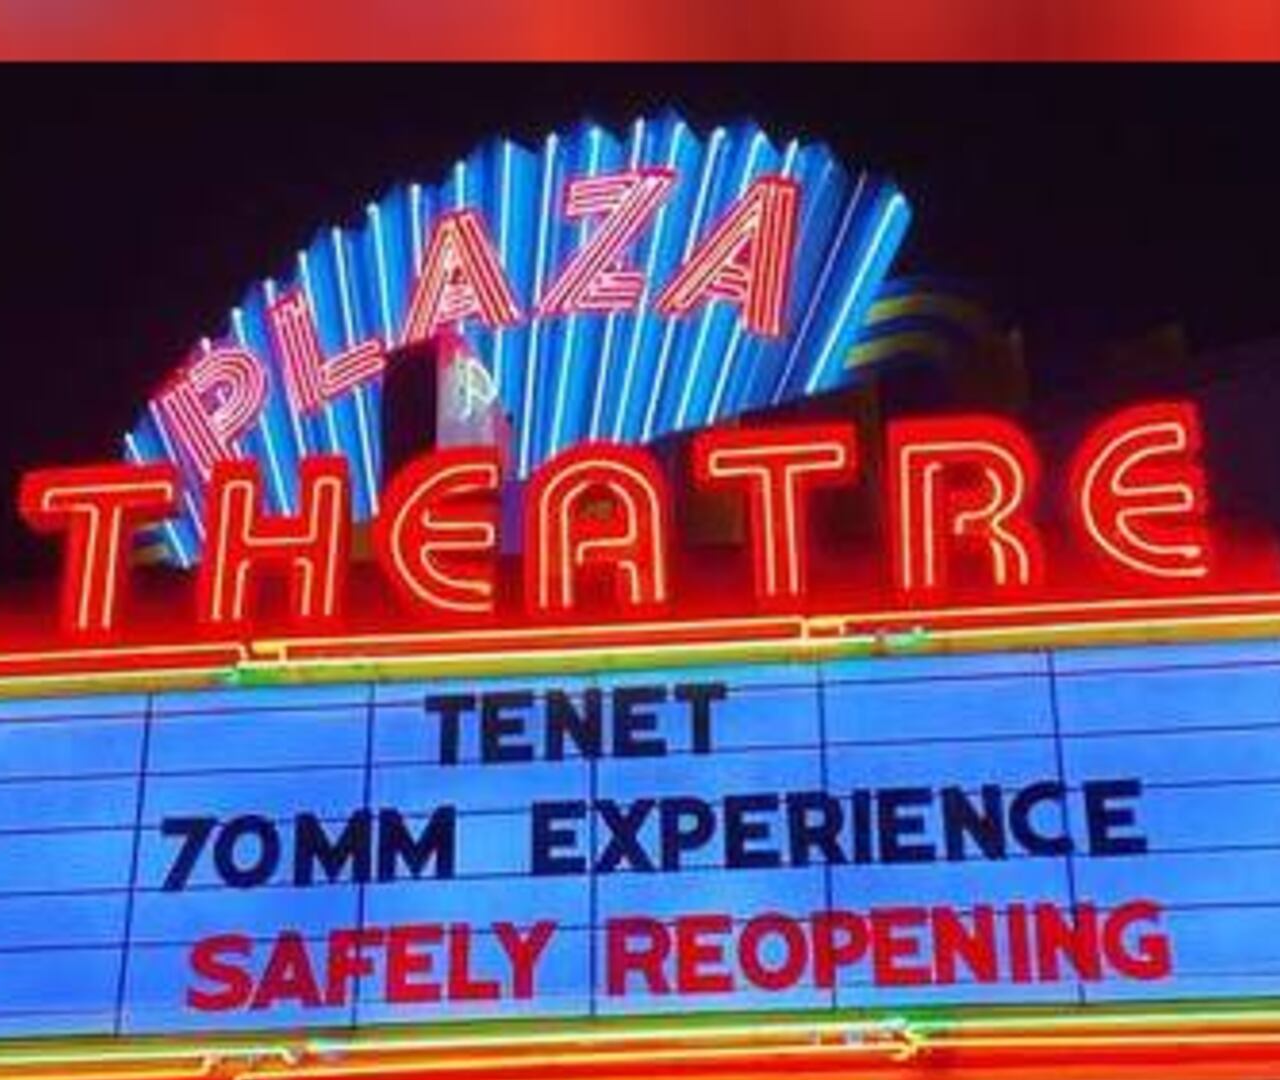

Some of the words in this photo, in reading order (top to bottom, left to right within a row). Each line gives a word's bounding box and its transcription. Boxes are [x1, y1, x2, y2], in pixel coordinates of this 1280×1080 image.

[150, 166, 802, 482] PLAZA
[22, 402, 1210, 634] THEATRE
[424, 682, 728, 767] TENET
[160, 804, 457, 891] 70MM
[530, 778, 1149, 877] EXPERIENCE
[185, 919, 558, 1012] SAFELY
[605, 899, 1173, 998] REOPENING
